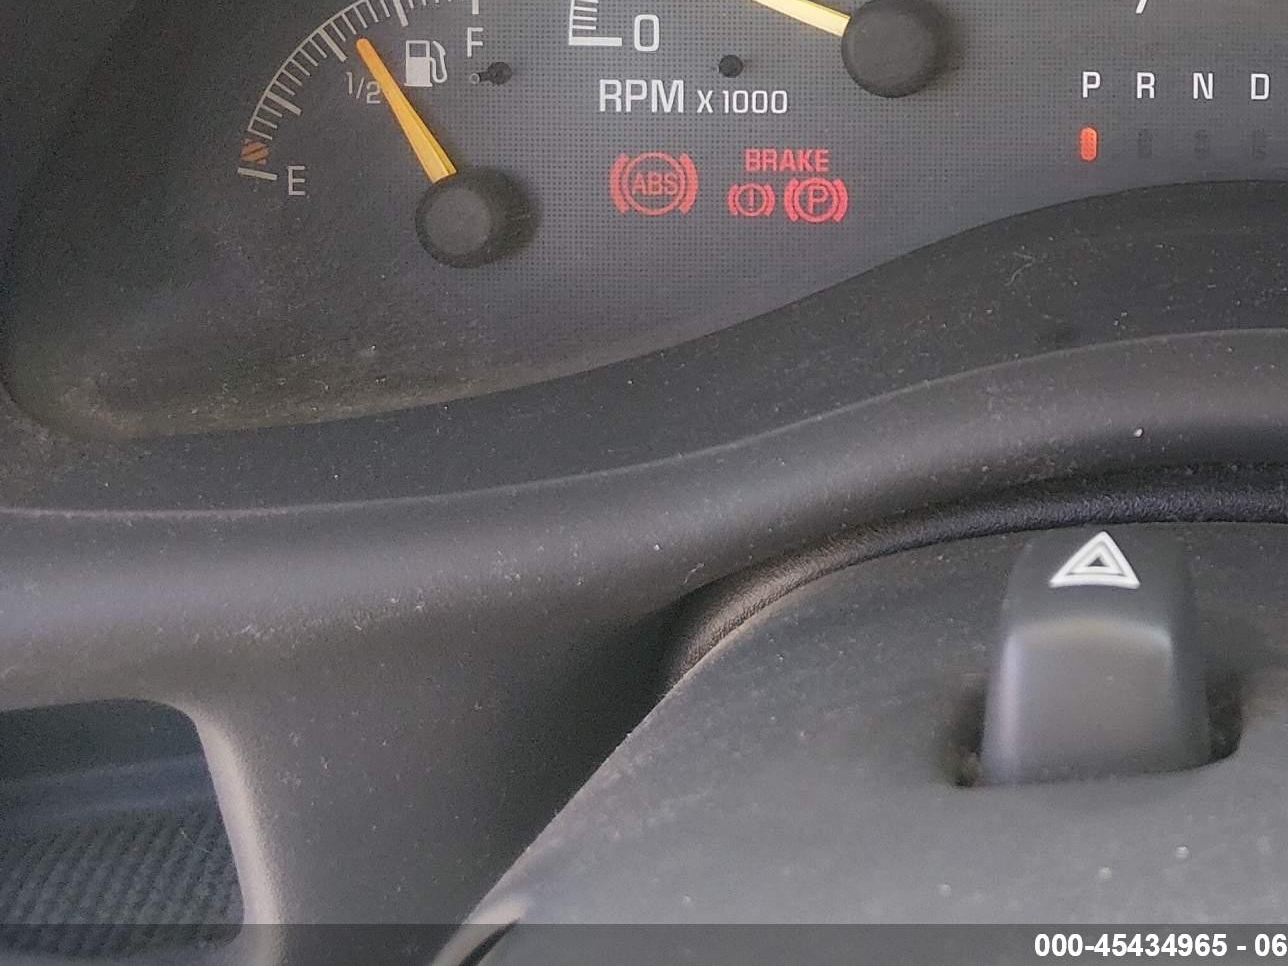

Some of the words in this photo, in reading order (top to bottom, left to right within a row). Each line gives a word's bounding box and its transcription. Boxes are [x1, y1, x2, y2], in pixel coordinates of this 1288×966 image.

[466, 26, 484, 58] F
[633, 14, 660, 52] 0
[345, 71, 382, 105] 1/2
[599, 79, 684, 114] RPM
[722, 90, 788, 114] 1000
[1082, 71, 1101, 98] P
[1136, 72, 1155, 99] R
[1193, 72, 1213, 100] N
[1250, 73, 1270, 100] D
[745, 148, 829, 172] BRAKE
[287, 165, 306, 196] E
[631, 171, 678, 196] ABS
[807, 185, 830, 214] P
